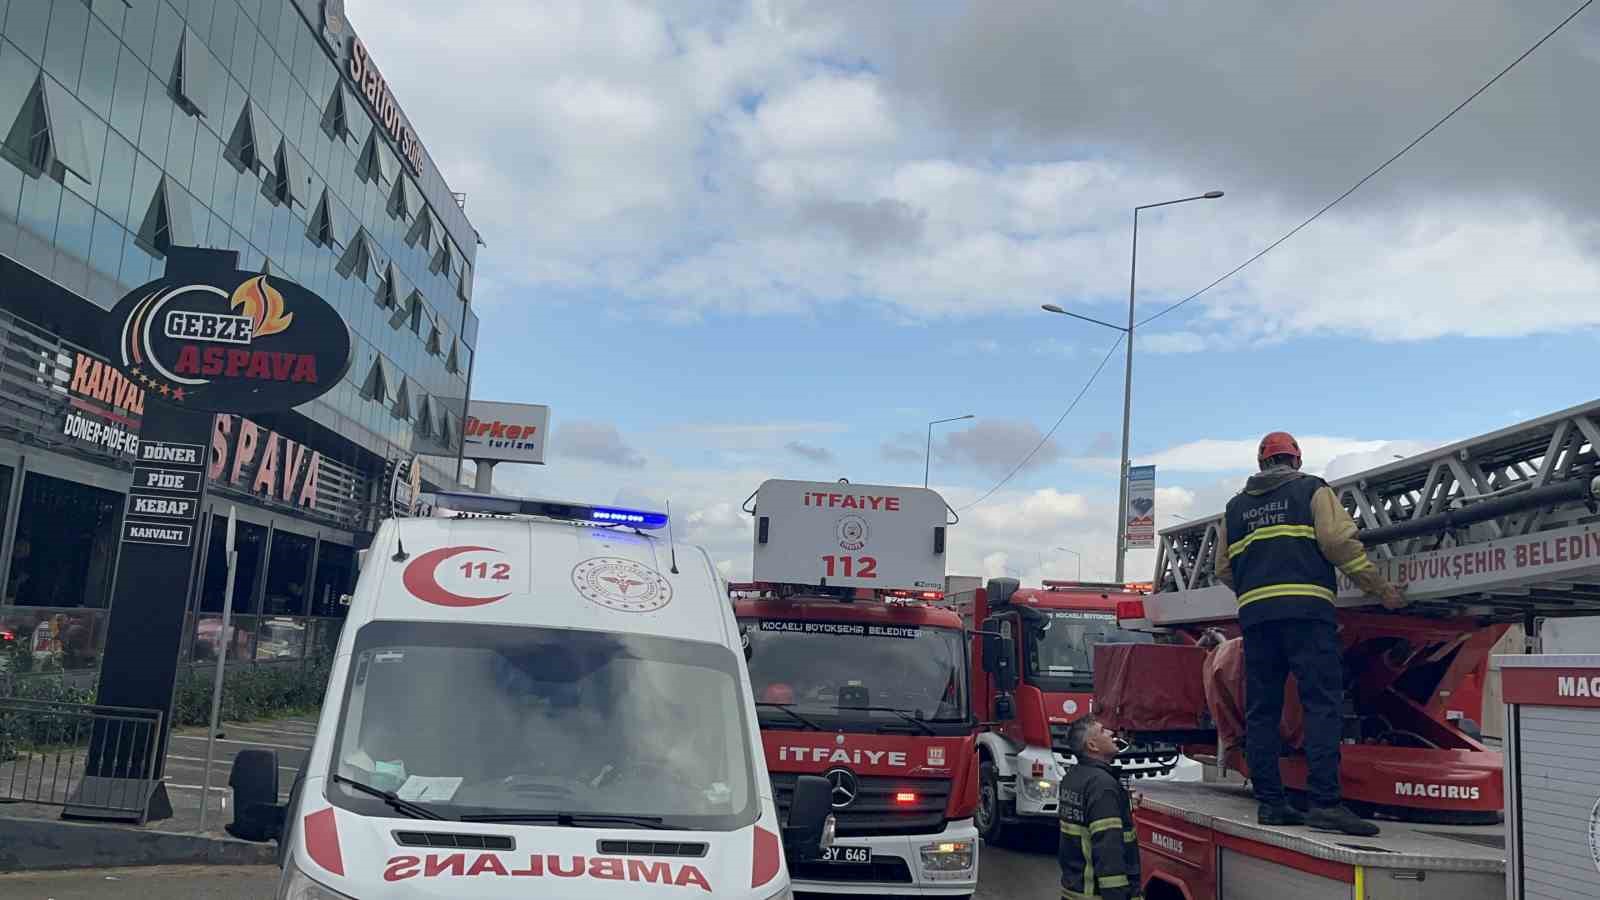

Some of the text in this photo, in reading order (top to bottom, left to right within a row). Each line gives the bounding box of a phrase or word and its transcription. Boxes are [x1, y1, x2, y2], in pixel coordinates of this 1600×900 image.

[350, 37, 401, 142] Station
[167, 313, 252, 341] GEBZE
[175, 344, 318, 384] ASPAVA
[143, 442, 196, 462] DÖNER
[488, 440, 534, 450] turizm
[147, 470, 185, 489] PİDE
[134, 499, 189, 515] KEBAP
[129, 527, 184, 541] KAHVALTI
[460, 562, 511, 579] 112
[821, 555, 877, 578] 112
[1399, 543, 1507, 583] BÜYÜKŞEHİR
[1395, 782, 1480, 799] MAGIRUS
[1152, 831, 1184, 853] MAGIRUS
[846, 849, 867, 861] 646
